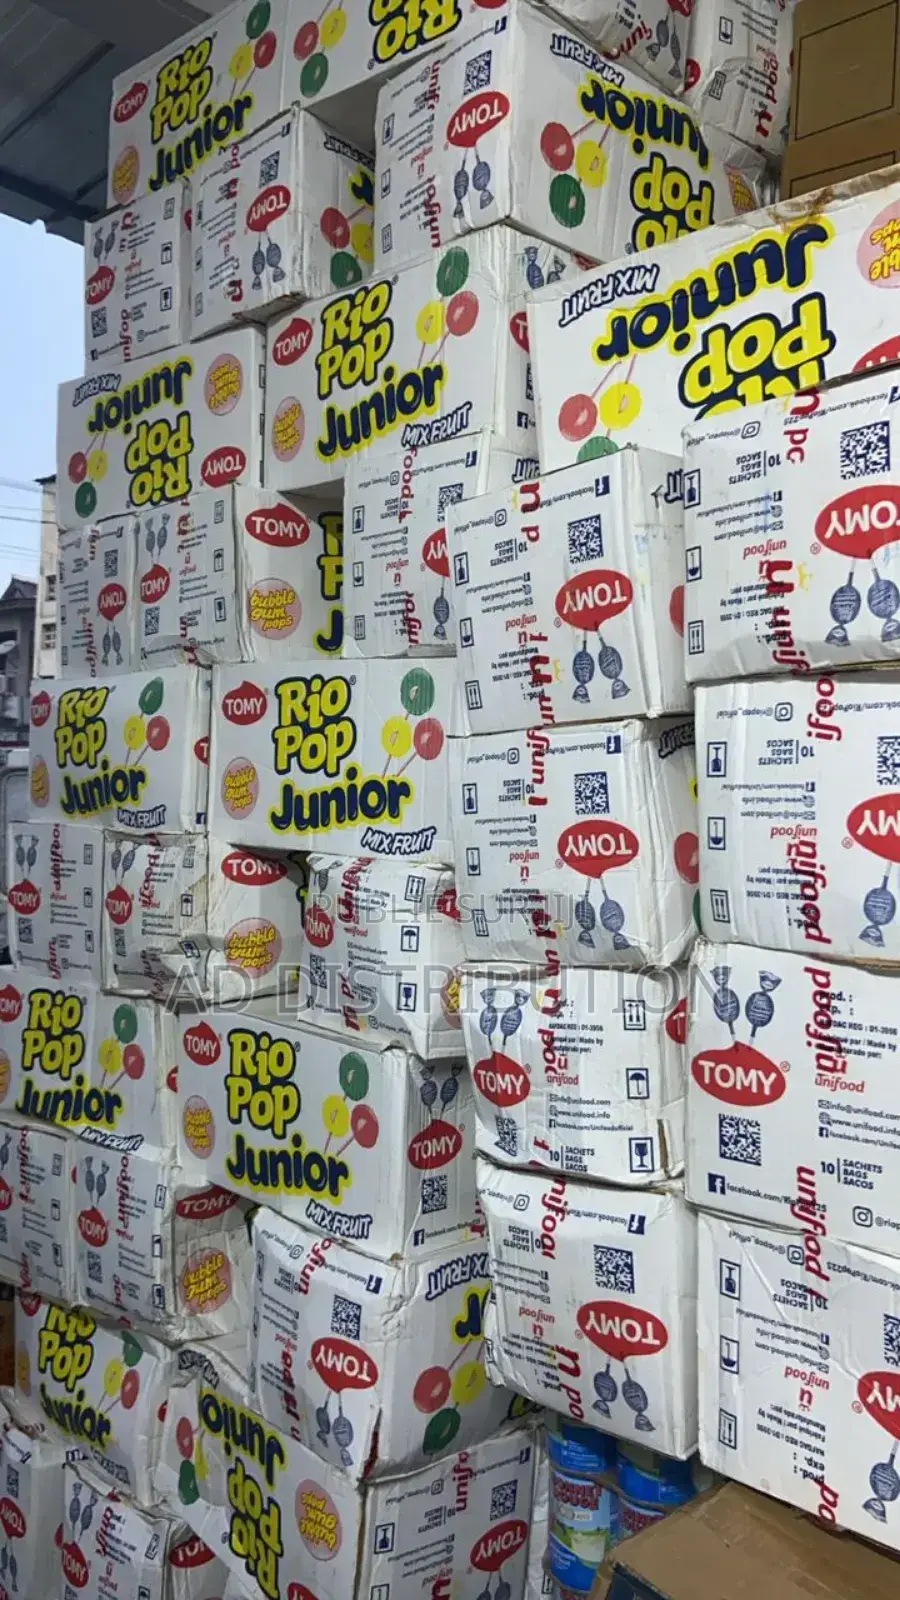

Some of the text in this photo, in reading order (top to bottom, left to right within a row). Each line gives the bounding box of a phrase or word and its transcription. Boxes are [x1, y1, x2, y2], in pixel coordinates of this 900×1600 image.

[550, 33, 604, 73] FRUIT
[157, 37, 213, 102] Rio
[115, 89, 148, 119] TOMY
[450, 97, 504, 139] TOMY
[148, 94, 253, 192] Junior
[249, 193, 288, 225] TOMY
[559, 263, 660, 328] MIX FRUIT
[596, 224, 829, 363] Junior
[321, 280, 393, 350] Rio
[275, 329, 311, 361] TOMY
[98, 373, 122, 393] MIX
[88, 361, 193, 434] Junior
[318, 365, 444, 457] Junior
[402, 401, 473, 448] MIX FRUIT
[204, 456, 242, 476] TOMY
[735, 450, 763, 466] SACOS
[740, 461, 763, 474] BAGS
[767, 454, 782, 468] 10
[129, 454, 193, 507] Rio
[728, 472, 762, 485] SACHETS
[251, 516, 305, 540] TOMY
[824, 500, 900, 540] OMY
[518, 541, 529, 553] 10
[743, 539, 788, 561] unifood
[140, 576, 168, 596] TOMY
[562, 579, 628, 615] TOMY
[100, 590, 125, 608] TOMY
[249, 589, 296, 608] bubble
[250, 606, 287, 622] gum
[263, 616, 293, 632] pops
[504, 613, 538, 632] unifood
[58, 686, 110, 729] Rio
[225, 698, 265, 716] TOMY
[274, 674, 352, 729] Rio
[766, 739, 794, 749] SACOS
[771, 748, 794, 757] BAGS
[800, 745, 816, 758] 10
[758, 756, 794, 766] SACHETS
[60, 759, 146, 815] Junior
[525, 784, 536, 795] 10
[270, 766, 412, 831] Junior
[117, 804, 167, 829] MIX FRUIT
[360, 825, 438, 856] MIX FRUIT
[770, 824, 818, 838] unifood
[564, 832, 634, 857] TOMY
[509, 849, 540, 864] unifood
[11, 890, 38, 909] TOMY
[105, 899, 131, 918] TOMY
[227, 925, 278, 950] bubble
[240, 953, 273, 969] pops
[28, 988, 83, 1036] Rio
[185, 1034, 218, 1058] TOMY
[227, 1027, 296, 1086] Rio
[476, 1069, 525, 1097] TOMY
[546, 1072, 580, 1088] unifood
[697, 1060, 778, 1096] TOMY
[815, 1072, 866, 1093] unifood
[15, 1074, 123, 1124] Junior
[412, 1134, 457, 1162] TOMY
[549, 1149, 560, 1162] 10
[564, 1146, 596, 1157] SACHETS
[564, 1154, 584, 1164] BAGS
[226, 1132, 349, 1198] Junior
[564, 1162, 589, 1173] SACOS
[820, 1160, 836, 1175] 10
[842, 1158, 883, 1174] SACHETS
[842, 1167, 869, 1180] BAGS
[842, 1176, 875, 1191] SACOS
[182, 1193, 233, 1214] TOMY
[80, 1217, 107, 1242] TOMY
[305, 1198, 374, 1241] MIX FRUIT
[425, 1256, 474, 1300] FRUIT
[780, 1278, 808, 1293] SACOS
[772, 1293, 809, 1311] SACHETS
[785, 1288, 809, 1301] BAGS
[518, 1306, 556, 1325] unifood
[584, 1309, 661, 1346] TOMY
[315, 1344, 372, 1382] TOMY
[784, 1366, 830, 1390] unifood
[803, 1455, 826, 1472] exp.
[798, 1467, 826, 1484] prod.
[475, 1527, 525, 1565] TOMY
[63, 1551, 87, 1584] TOMY
